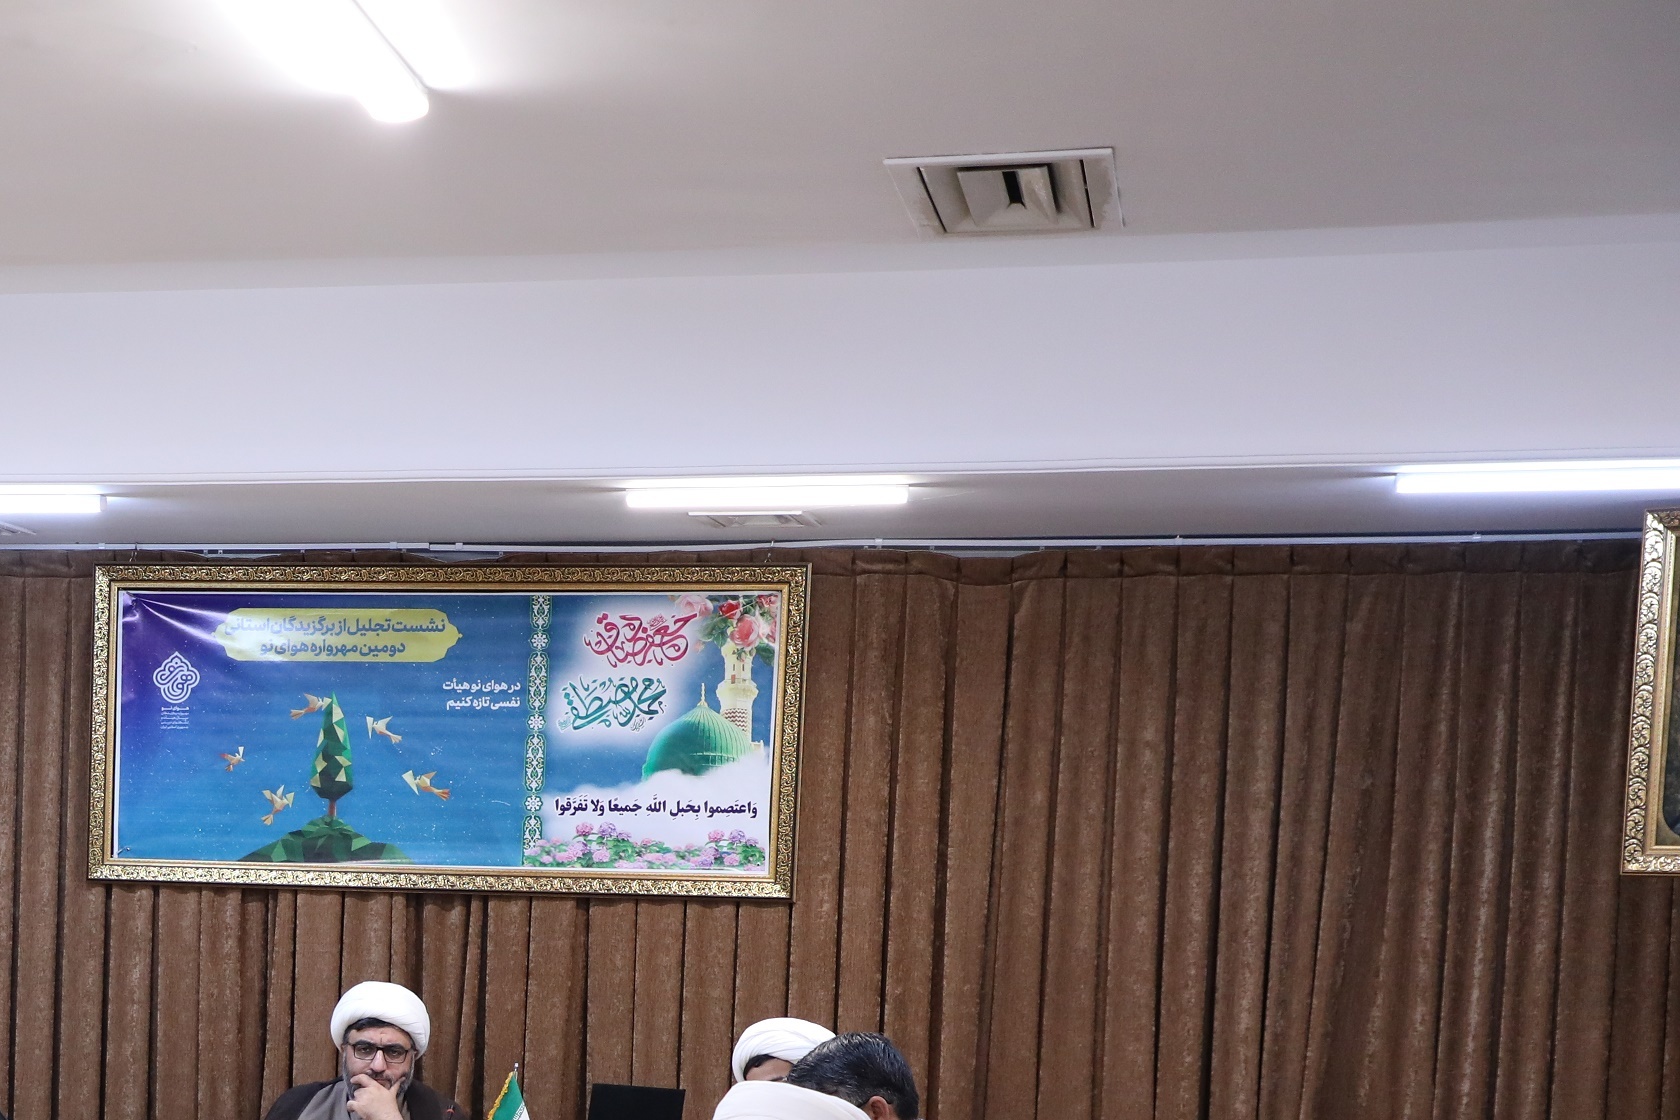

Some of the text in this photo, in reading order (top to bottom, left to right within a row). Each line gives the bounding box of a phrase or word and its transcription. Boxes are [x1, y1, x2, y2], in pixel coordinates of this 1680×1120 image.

[271, 615, 336, 638] برگزیدگان
[334, 617, 349, 637] از
[349, 617, 391, 637] تجلیل
[391, 618, 446, 633] نشست
[260, 639, 406, 657] دومین مهرواره هوای نو
[442, 677, 521, 693] در هوای نو هیأت
[446, 696, 520, 710] نفسی تازه کنیم
